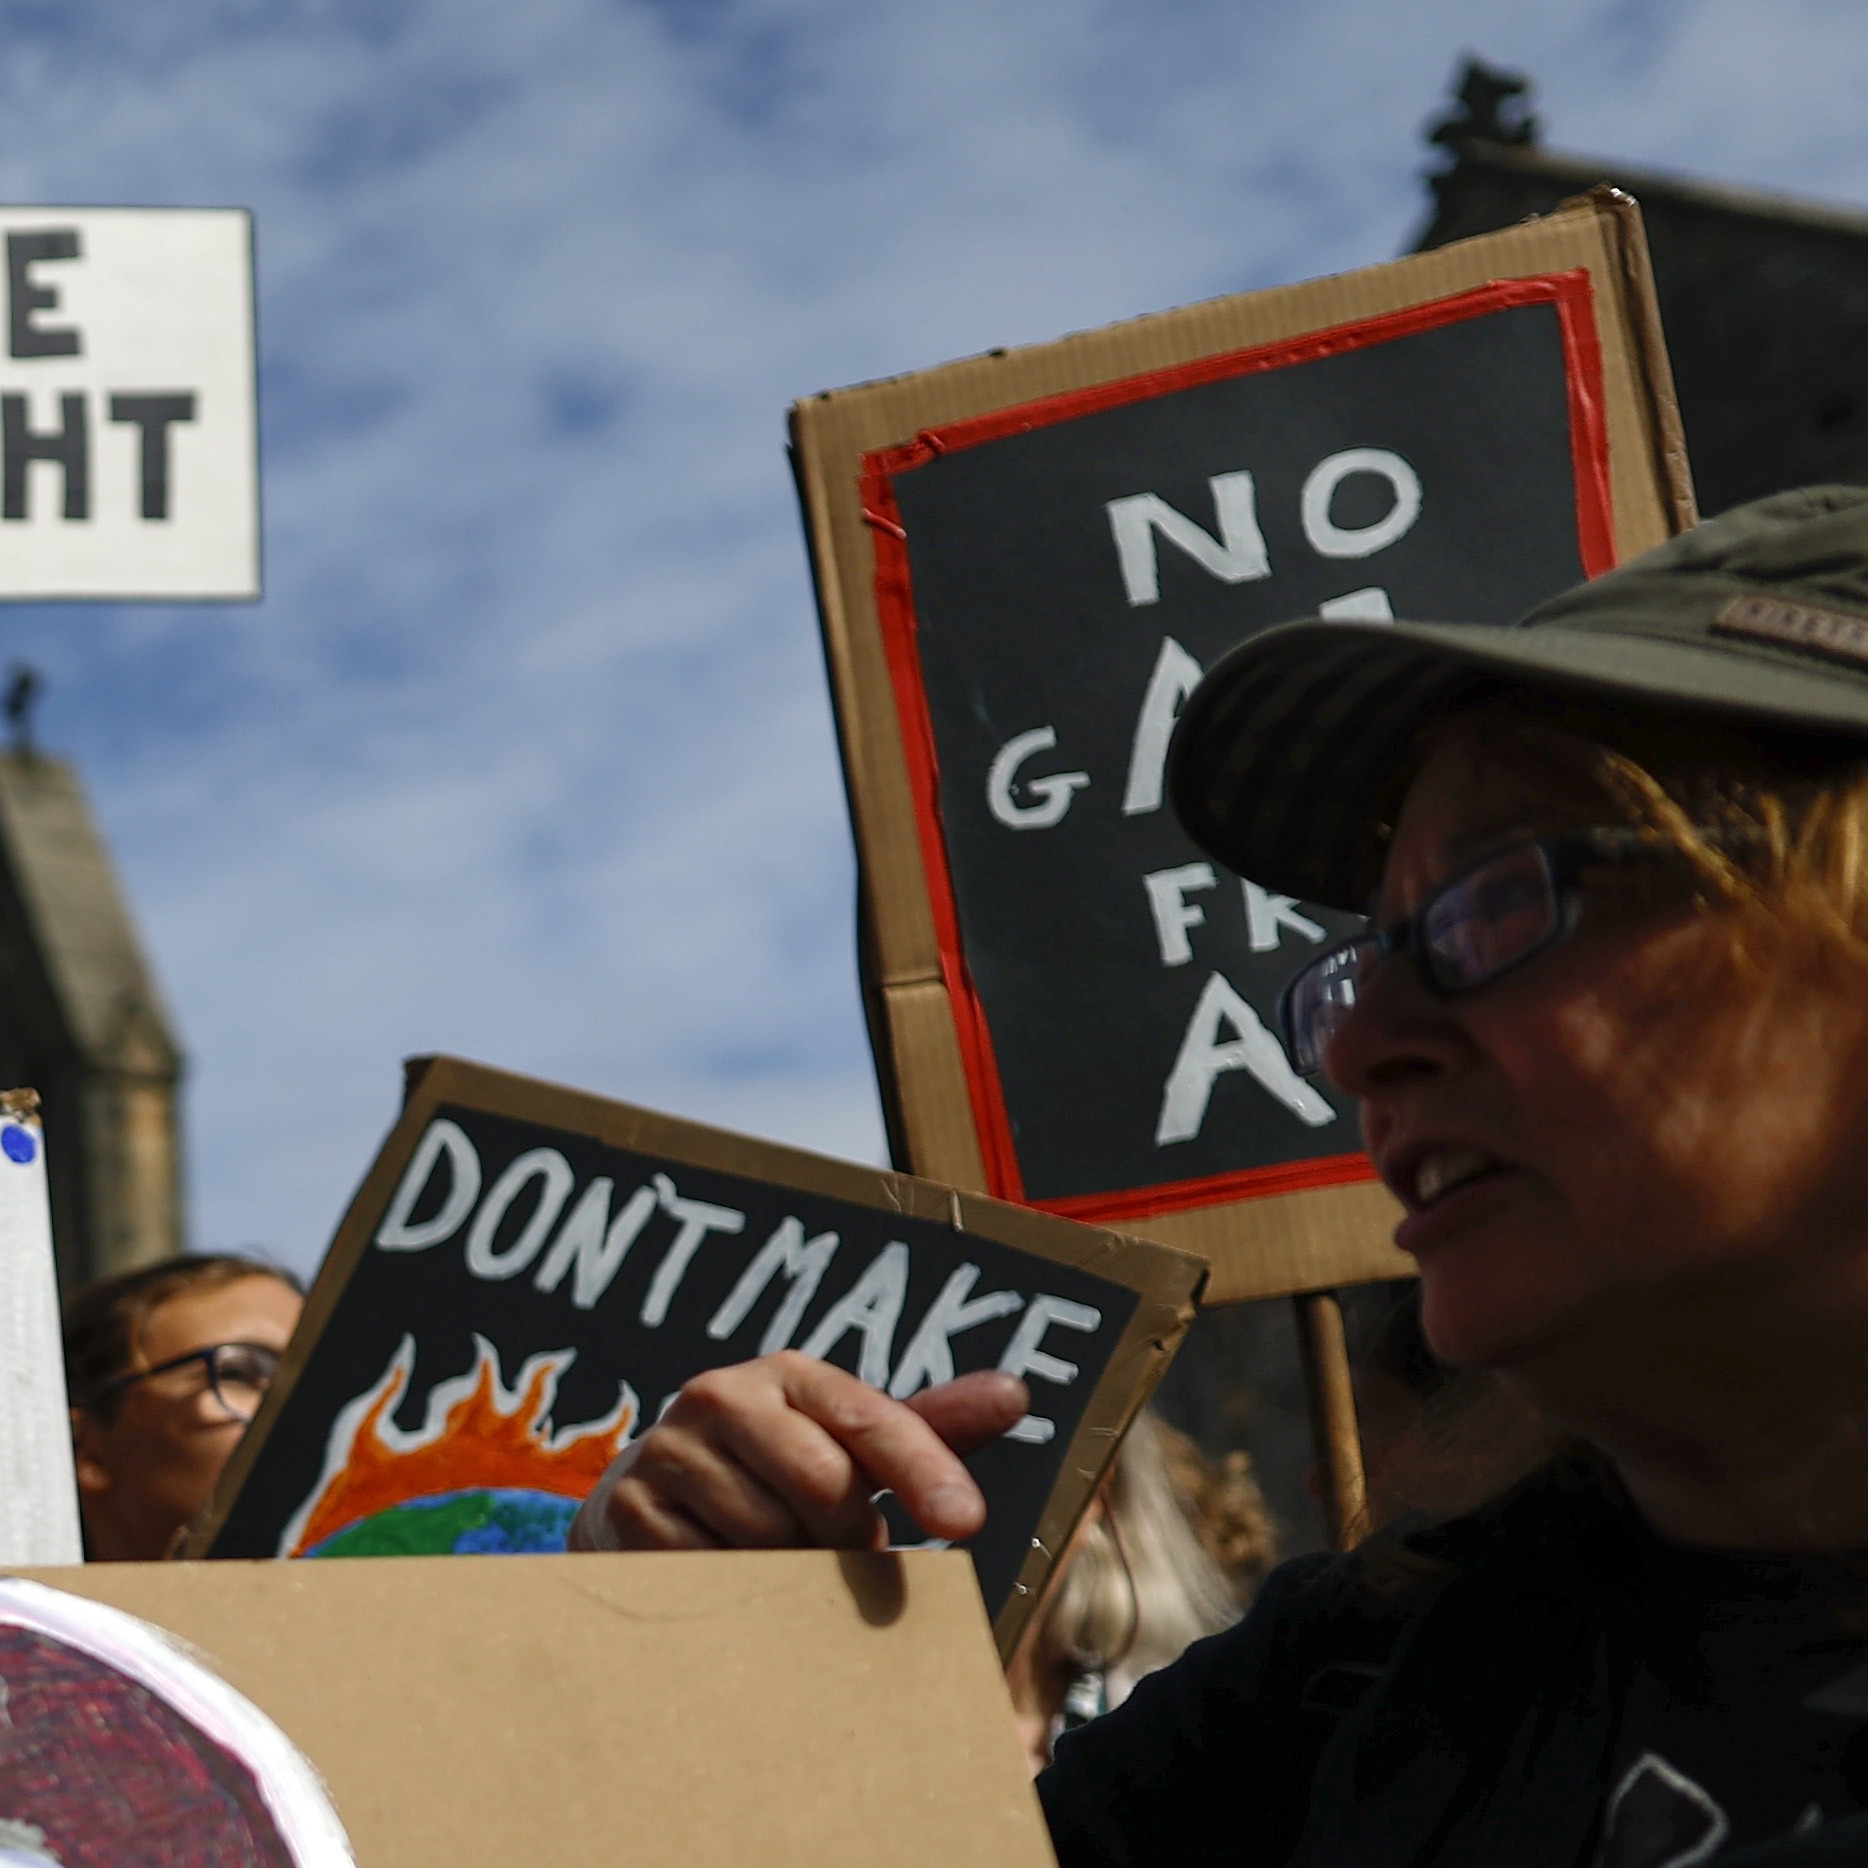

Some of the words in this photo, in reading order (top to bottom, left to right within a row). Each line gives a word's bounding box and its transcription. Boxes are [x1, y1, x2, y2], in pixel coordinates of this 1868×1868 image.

[1104, 446, 1423, 606] NO
[376, 1118, 746, 1329] DON'T
[708, 1215, 1102, 1445] MAKE
